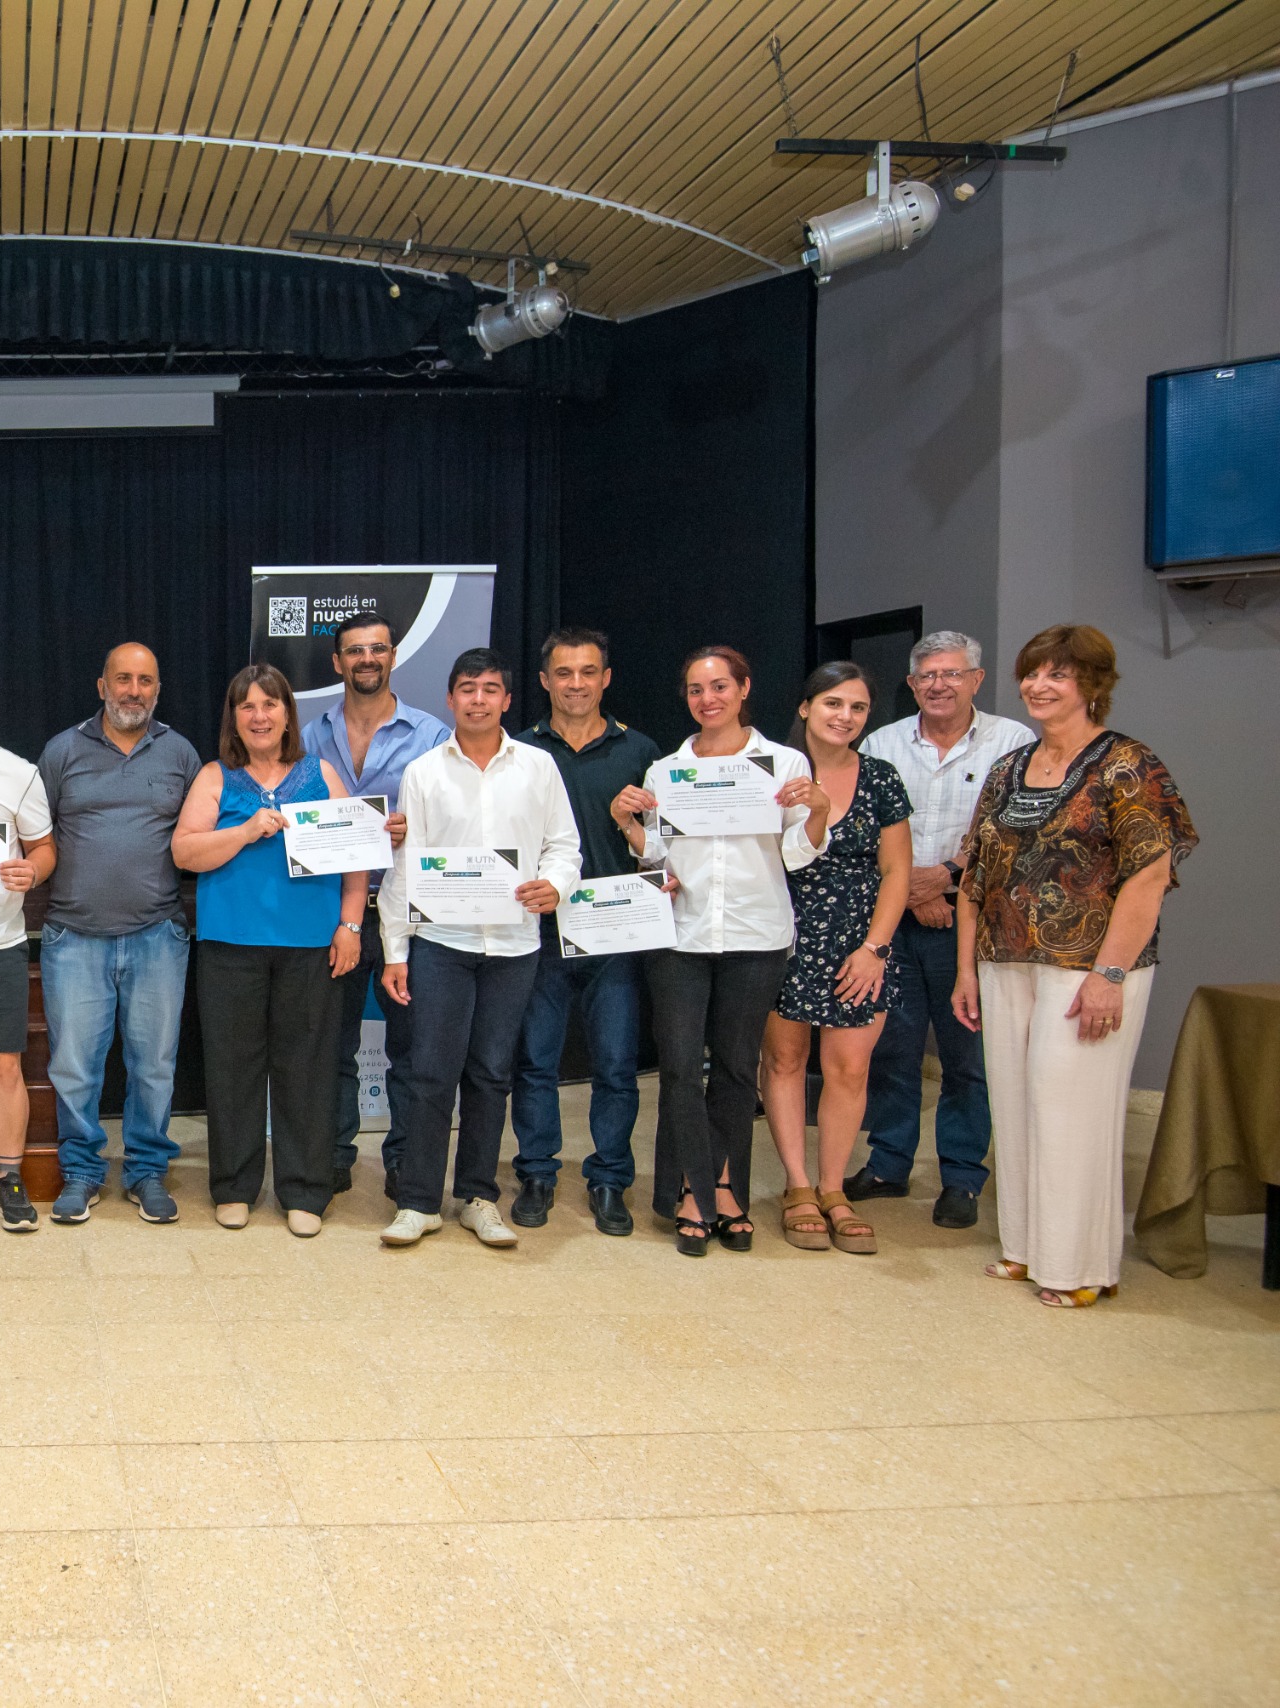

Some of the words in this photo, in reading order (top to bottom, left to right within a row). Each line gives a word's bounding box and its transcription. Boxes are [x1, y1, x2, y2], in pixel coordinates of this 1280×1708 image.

[313, 595, 358, 608] estudiá
[361, 598, 376, 607] en
[727, 764, 750, 772] UTN
[345, 805, 365, 813] UTN
[622, 882, 644, 891] UTN
